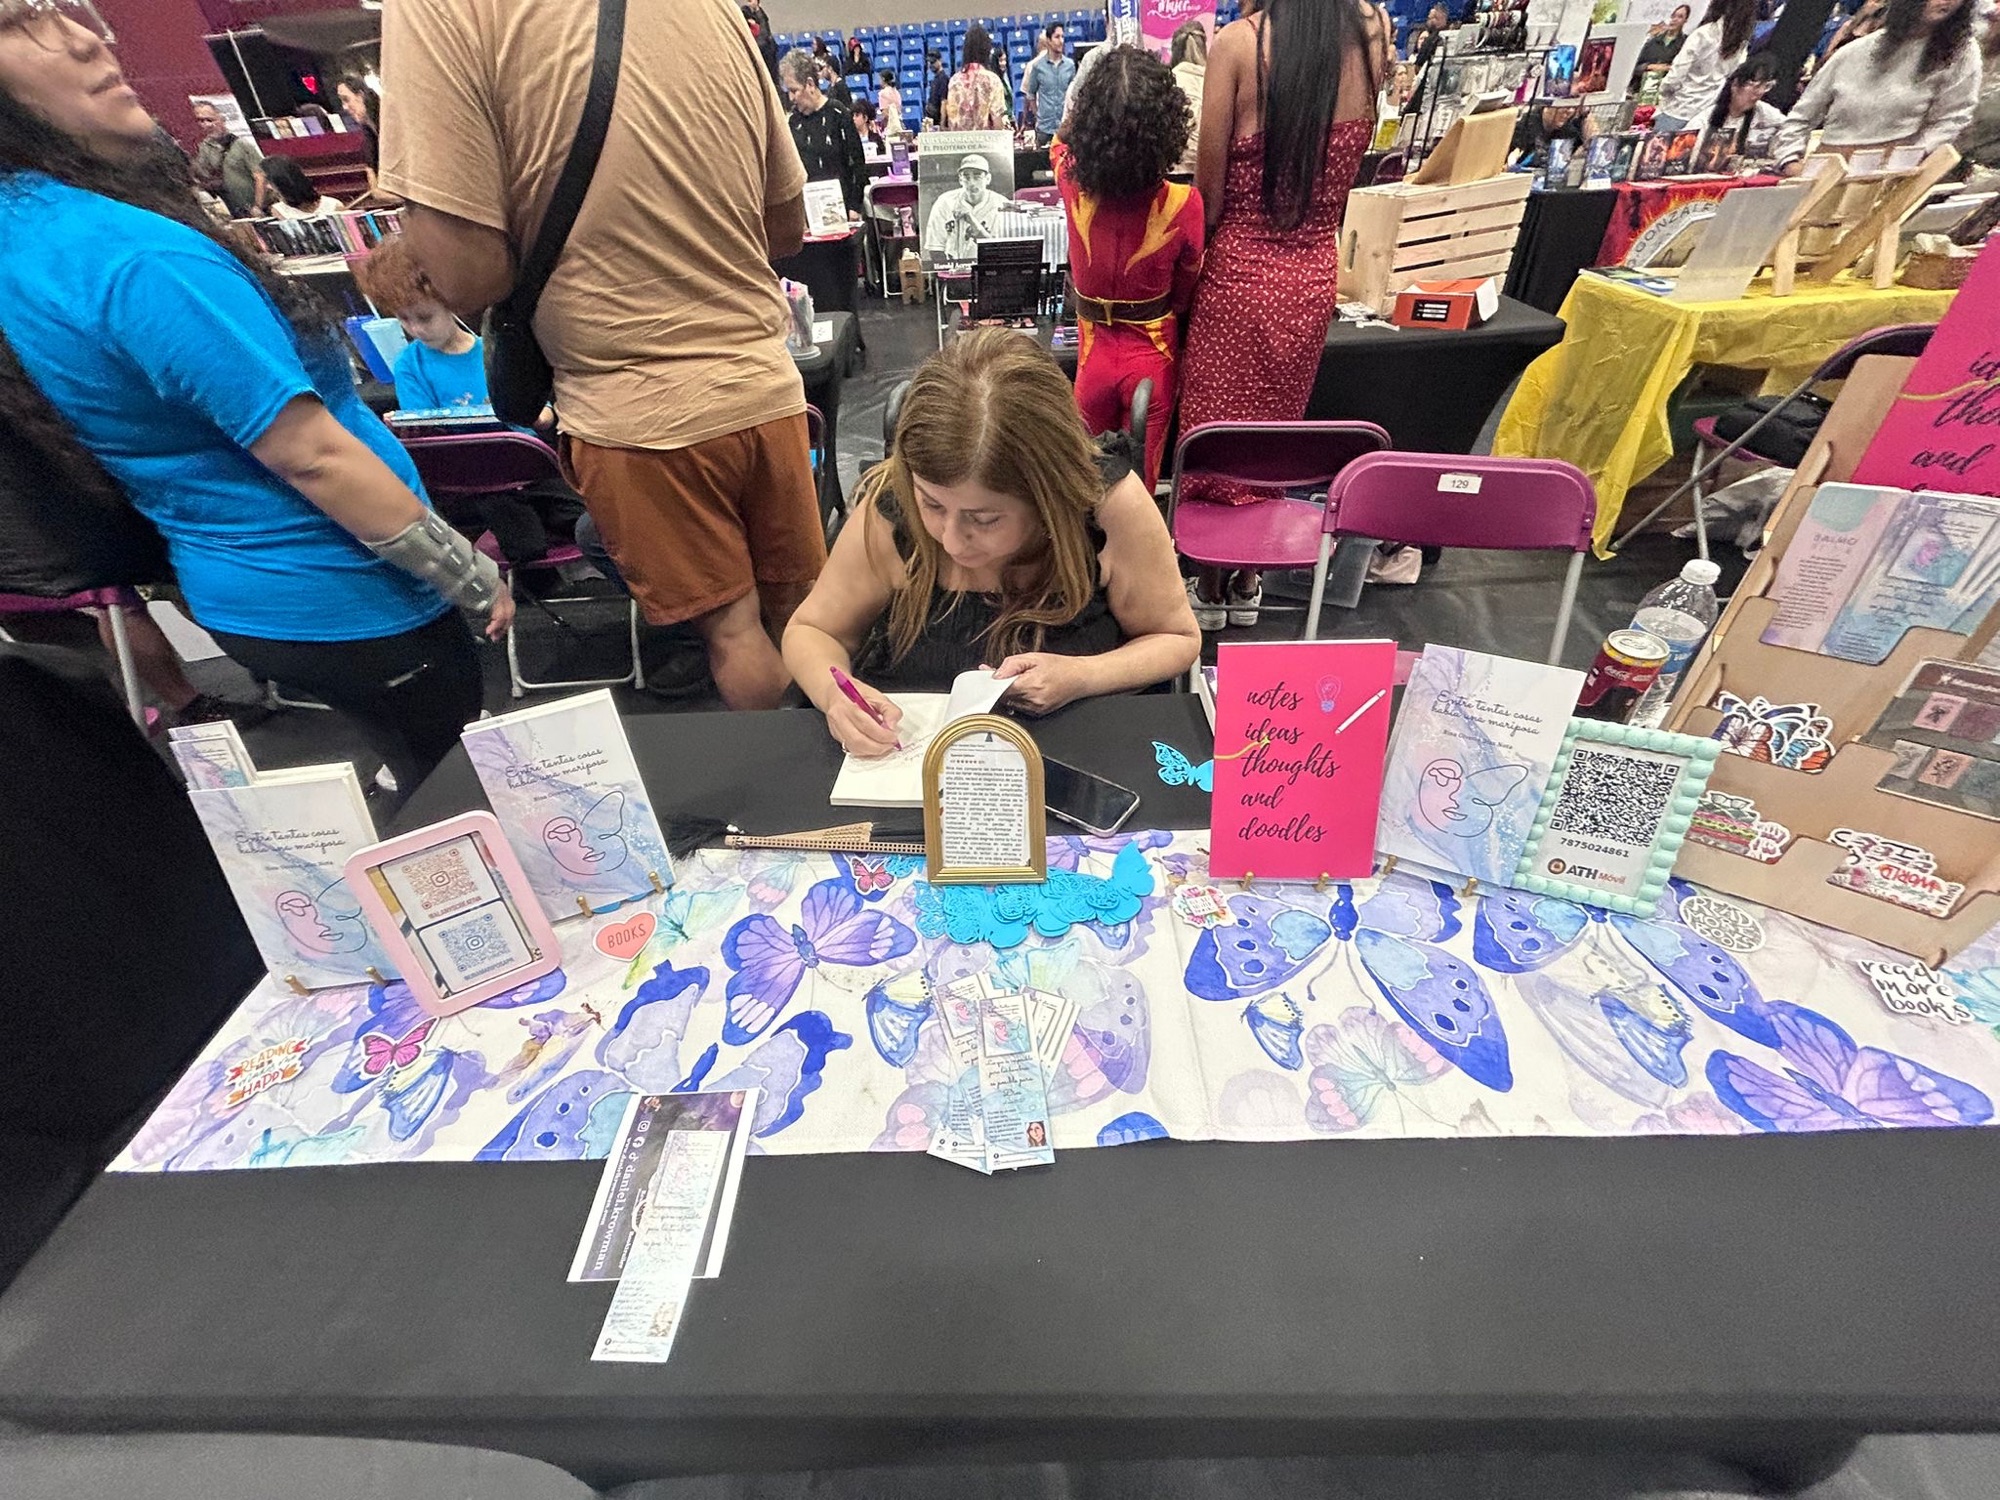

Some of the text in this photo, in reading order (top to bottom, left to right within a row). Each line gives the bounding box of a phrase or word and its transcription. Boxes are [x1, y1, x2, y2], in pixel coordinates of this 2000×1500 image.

[1911, 444, 1996, 476] and
[1452, 480, 1469, 489] 129
[1247, 682, 1304, 711] notes
[1436, 690, 1542, 723] Entre tantas cosas
[1245, 718, 1304, 745] ideas
[1463, 713, 1486, 723] una
[1488, 718, 1540, 737] mariposa
[505, 749, 603, 778] Entre tantas cosas
[562, 758, 608, 775] mariposa
[1241, 742, 1341, 786] thoughts
[1241, 785, 1284, 809] and
[234, 828, 340, 844] Entre tantas cosas
[1238, 813, 1328, 842] doodles
[294, 840, 346, 854] mariposa
[1560, 837, 1630, 858] 7875024861
[1566, 864, 1598, 880] ATH
[608, 923, 646, 948] BOOKS
[1862, 962, 1940, 984] read
[1876, 979, 1952, 997] more
[1886, 992, 1970, 1021] books
[240, 1041, 296, 1072] READING
[243, 1064, 289, 1096] HAPPY
[594, 1165, 636, 1270] daniel.krowman
